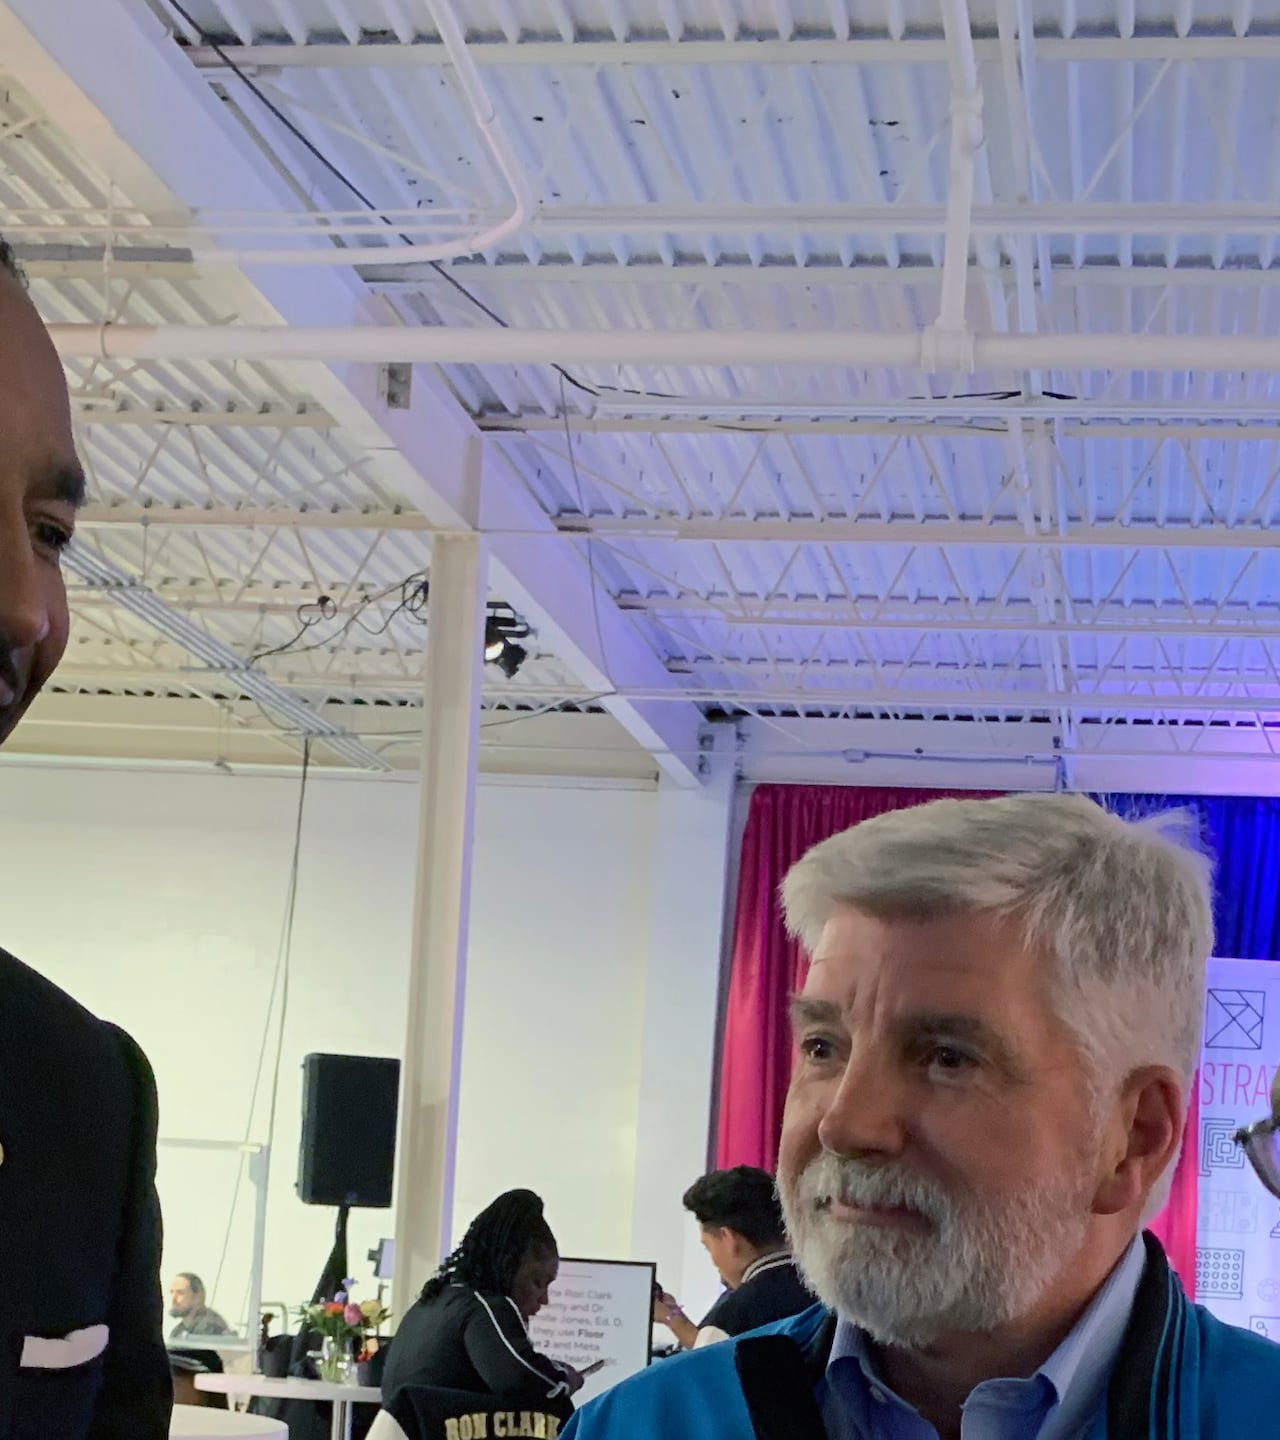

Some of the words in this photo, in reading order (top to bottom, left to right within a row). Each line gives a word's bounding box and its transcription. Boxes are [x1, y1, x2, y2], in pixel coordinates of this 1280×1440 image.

[1201, 1062, 1280, 1107] STRA
[564, 1288, 585, 1299] Ron
[587, 1289, 612, 1300] Clark
[577, 1328, 605, 1339] Floor
[574, 1341, 601, 1352] Meta
